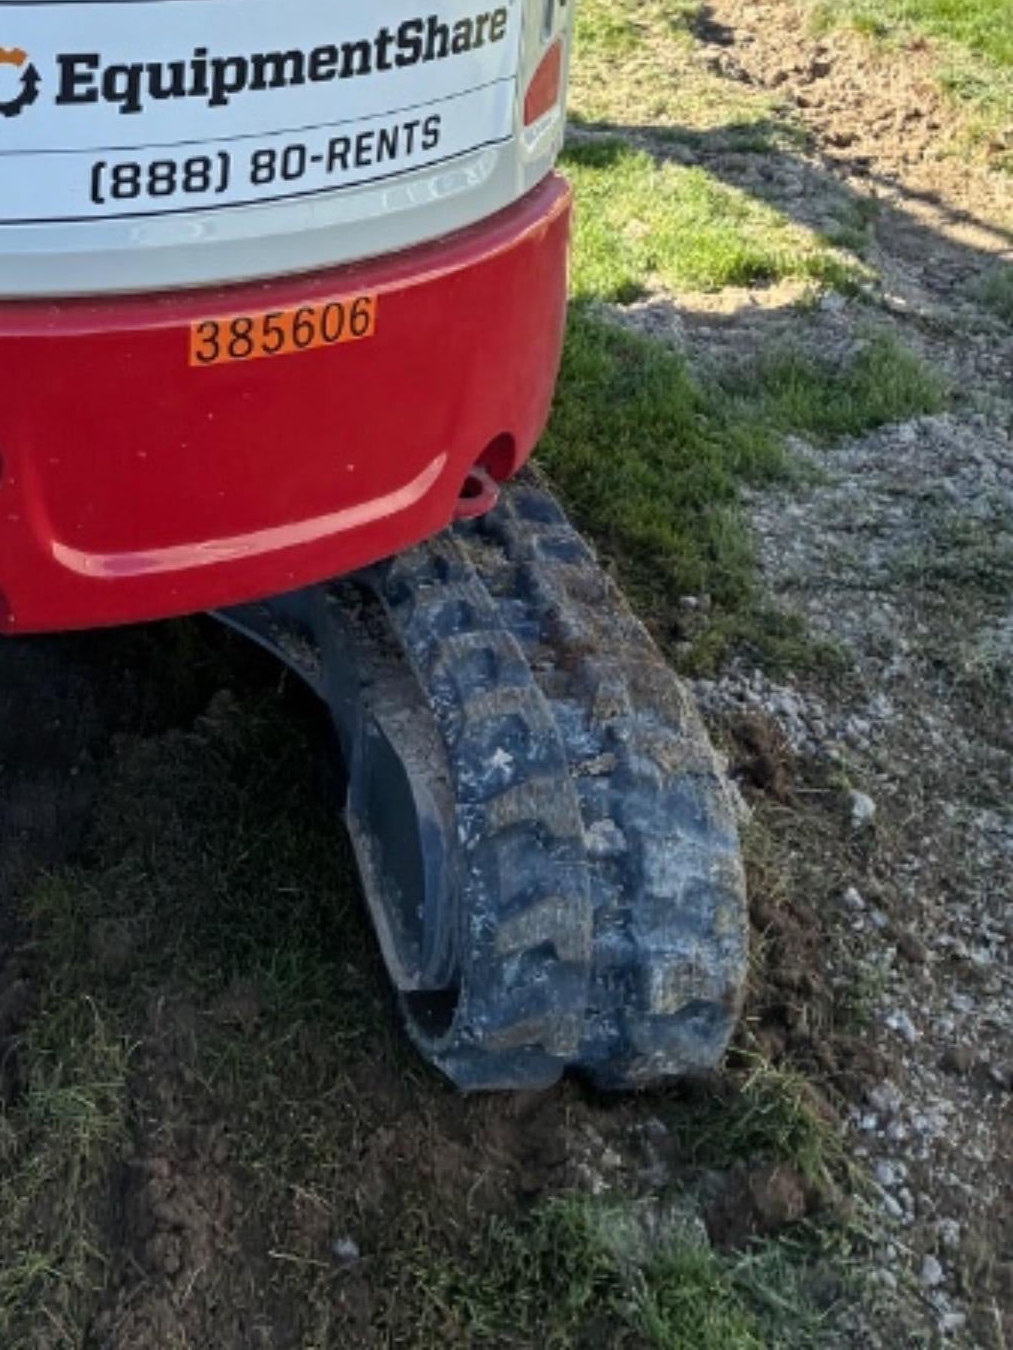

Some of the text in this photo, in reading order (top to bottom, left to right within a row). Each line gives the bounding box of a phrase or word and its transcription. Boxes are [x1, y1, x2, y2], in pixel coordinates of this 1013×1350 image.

[55, 6, 506, 114] EquipmentShare
[90, 114, 441, 204] (888) 80-RENTS
[196, 296, 372, 363] 385606
